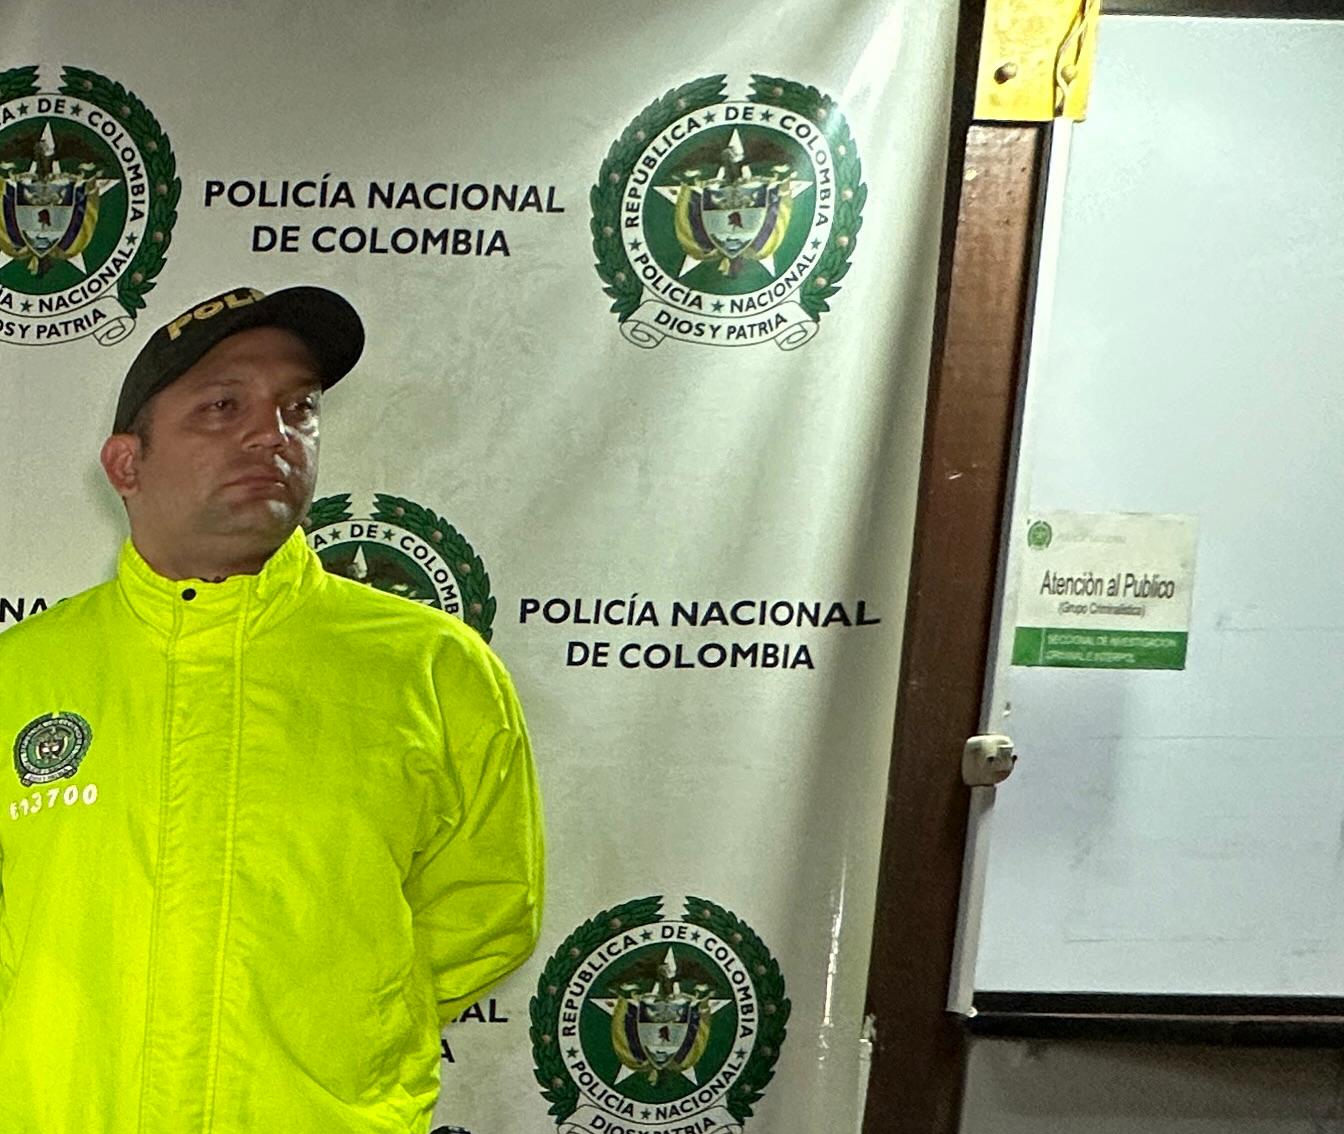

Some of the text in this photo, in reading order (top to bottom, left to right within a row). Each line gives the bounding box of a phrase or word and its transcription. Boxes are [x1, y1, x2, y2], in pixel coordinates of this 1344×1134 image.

[37, 97, 66, 113] DE
[87, 110, 146, 221] COLOMBIA
[725, 106, 754, 121] DE
[780, 115, 830, 226] COLOMBIA
[205, 173, 564, 212] POLICÍA NACIONAL
[253, 226, 510, 256] DE COLOMBIA
[39, 247, 133, 313] NACIONAL
[730, 253, 816, 312] NACIONAL
[37, 308, 106, 339] PATRIA
[727, 312, 788, 340] PATRIA
[350, 524, 458, 614] DE COLOMB
[520, 593, 882, 632] POLICÍA NACIONAL
[567, 642, 814, 669] DE COLOMBIA
[662, 926, 688, 938] DE
[704, 938, 754, 1038] COLOMBIA
[656, 1062, 742, 1120] NACIONAL
